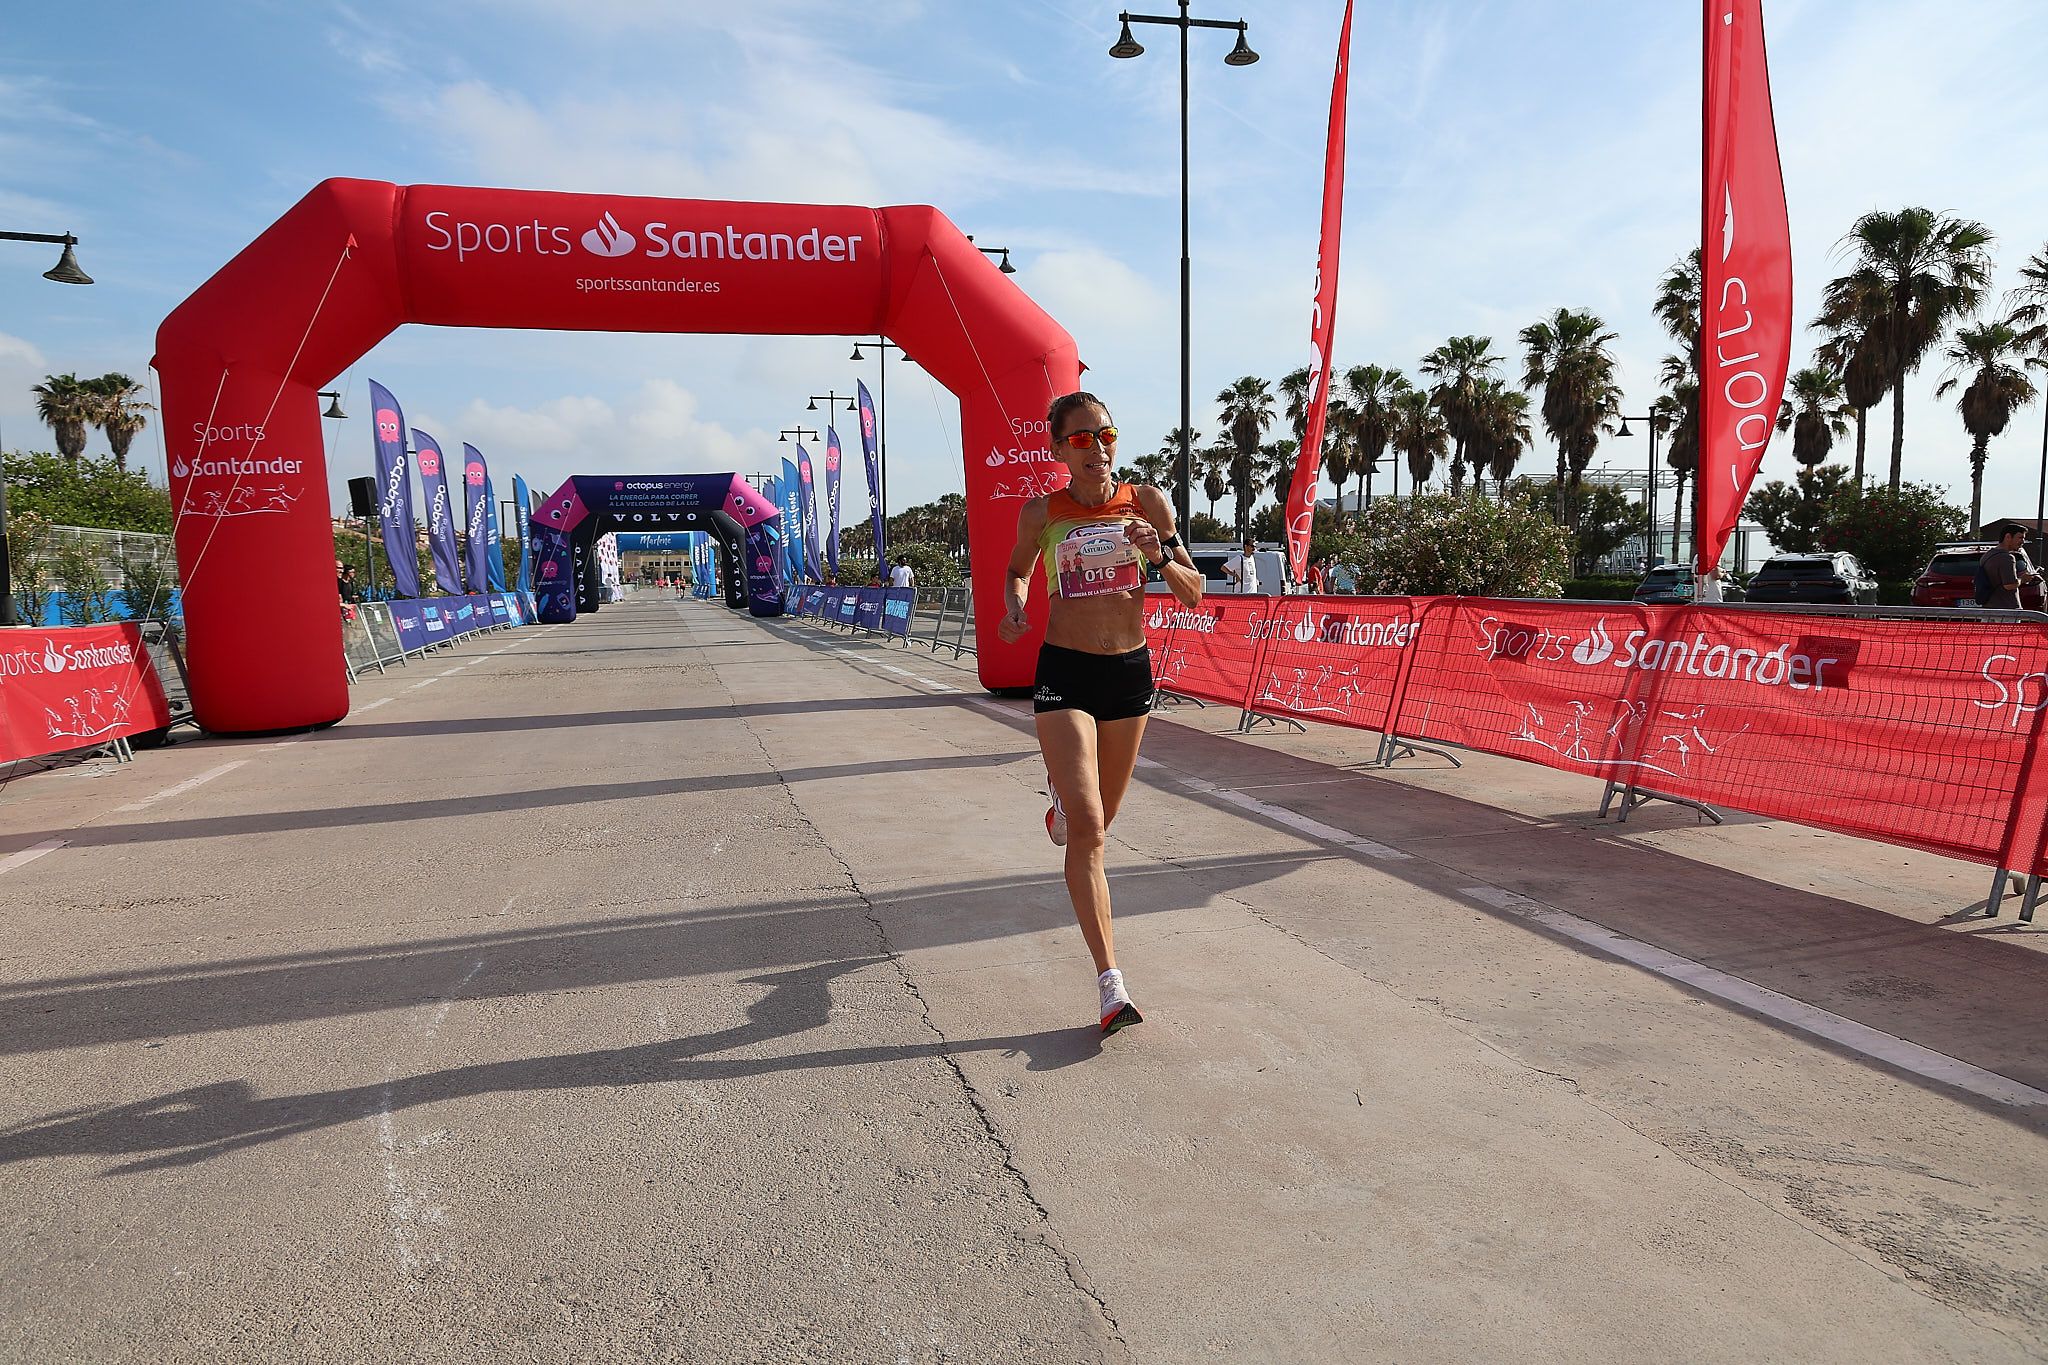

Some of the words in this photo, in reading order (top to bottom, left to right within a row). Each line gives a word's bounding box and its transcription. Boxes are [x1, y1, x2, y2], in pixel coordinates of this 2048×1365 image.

[425, 211, 572, 263] Sports
[643, 222, 862, 262] Santander
[576, 276, 720, 293] sportssantander.es
[193, 422, 266, 447] Sports
[1011, 417, 1052, 438] Spor
[191, 456, 303, 477] Santander
[1008, 446, 1055, 465] Santa
[613, 512, 697, 522] VOLVO
[1082, 544, 1114, 554] ASTURIANA
[575, 546, 586, 605] VOLVO
[731, 543, 742, 600] VOLVO
[1084, 566, 1116, 582] 016
[1162, 607, 1218, 634] Santander
[1244, 612, 1292, 645] Sports
[1316, 614, 1420, 647] Santander
[0, 648, 43, 685] ports
[62, 640, 134, 671] Santander
[1475, 617, 1571, 662] Sports
[1614, 629, 1838, 692] Santander
